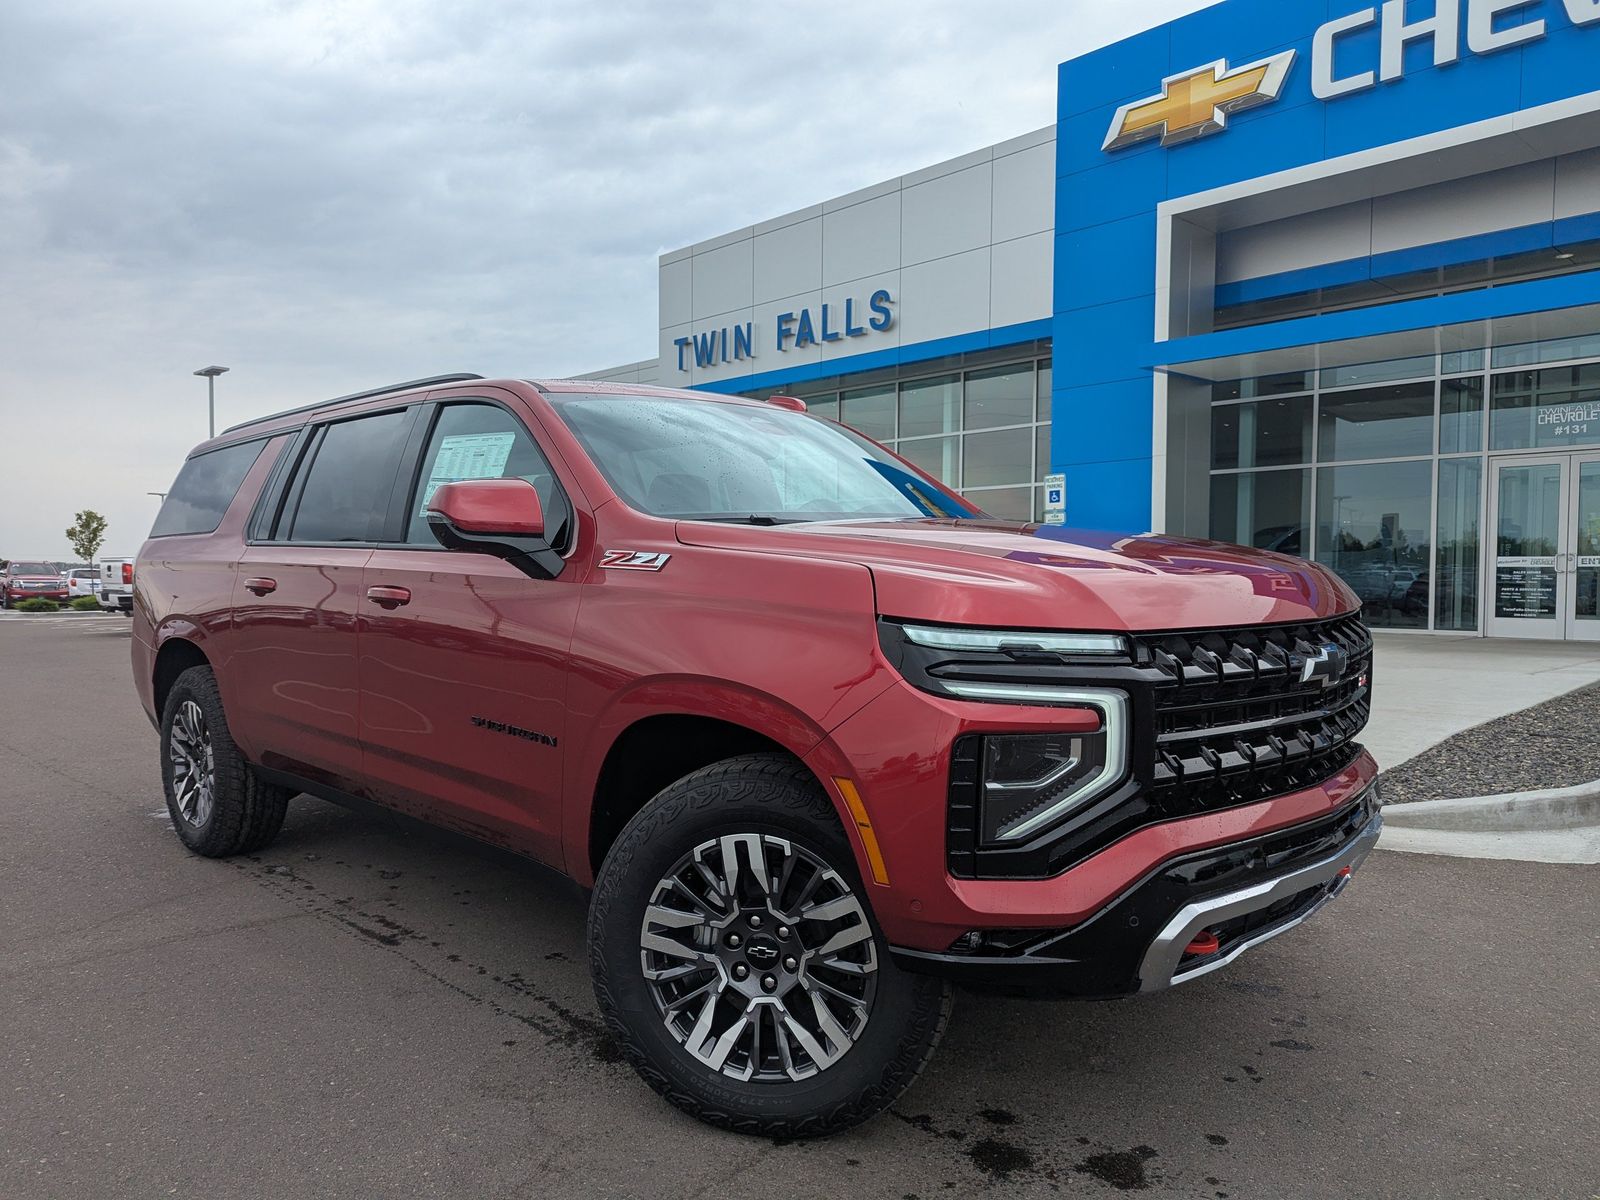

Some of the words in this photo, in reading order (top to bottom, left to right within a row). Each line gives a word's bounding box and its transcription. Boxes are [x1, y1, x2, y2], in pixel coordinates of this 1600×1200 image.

[673, 322, 756, 371] TWIN
[776, 289, 895, 352] FALLS
[1554, 424, 1587, 435] #131
[470, 715, 558, 747] SUBURBAN
